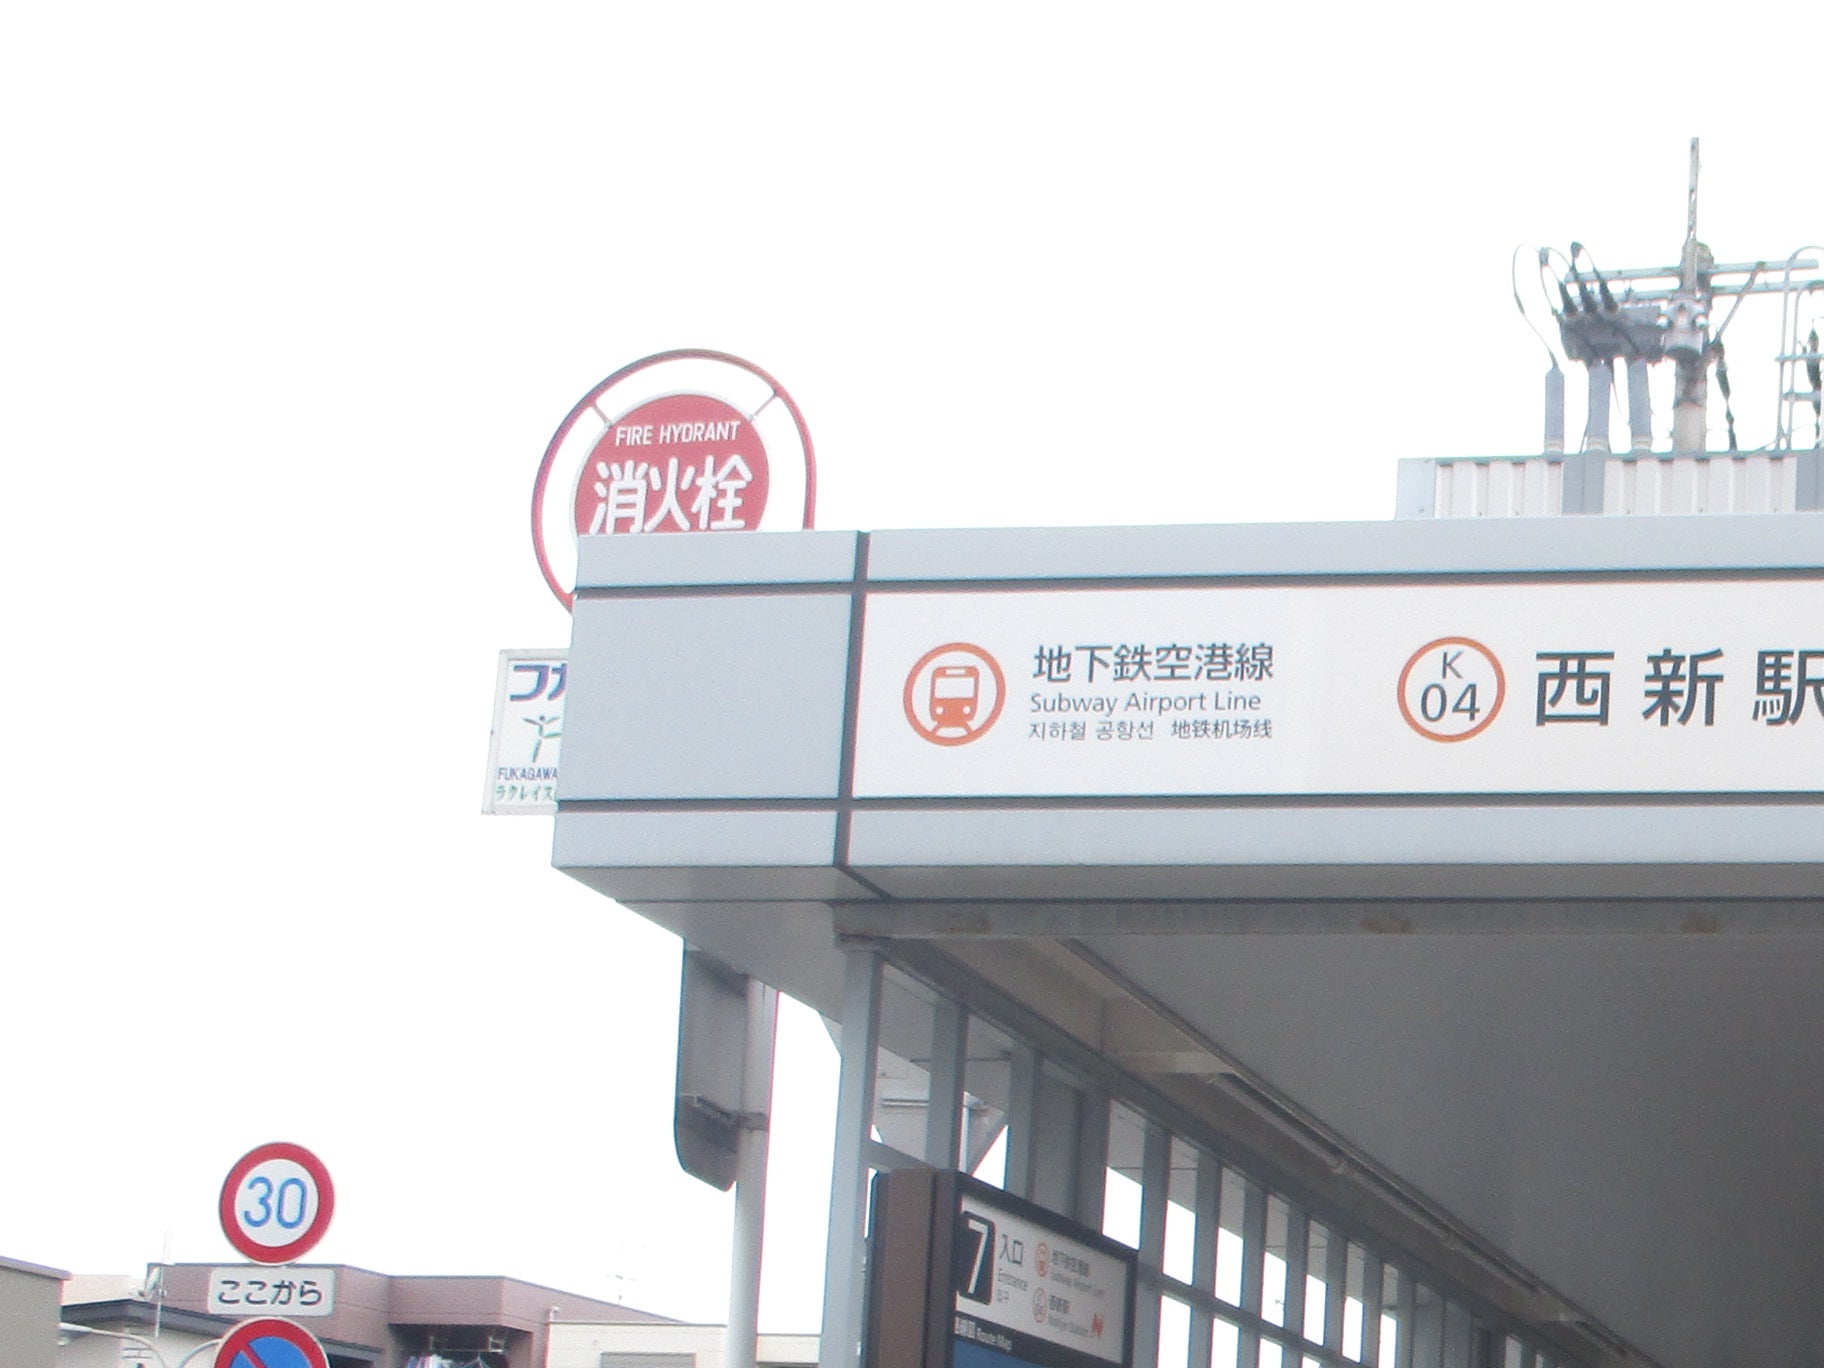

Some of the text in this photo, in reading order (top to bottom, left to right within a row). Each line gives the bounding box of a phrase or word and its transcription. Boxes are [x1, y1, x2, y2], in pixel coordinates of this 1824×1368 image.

[615, 421, 741, 446] FIRE HYDRANT
[589, 453, 753, 535] 消火栓
[1032, 642, 1274, 684] 地下鉄空港線
[1441, 651, 1464, 680] K
[1030, 690, 1261, 717] Subway Airport Line
[1420, 683, 1481, 722] 04
[1029, 720, 1154, 741] 지하철 공항선
[1171, 718, 1273, 740] 地铁机场线
[243, 1176, 309, 1230] 30
[967, 1218, 989, 1294] 7
[1000, 1234, 1023, 1266] 入口
[218, 1279, 323, 1306] ここから
